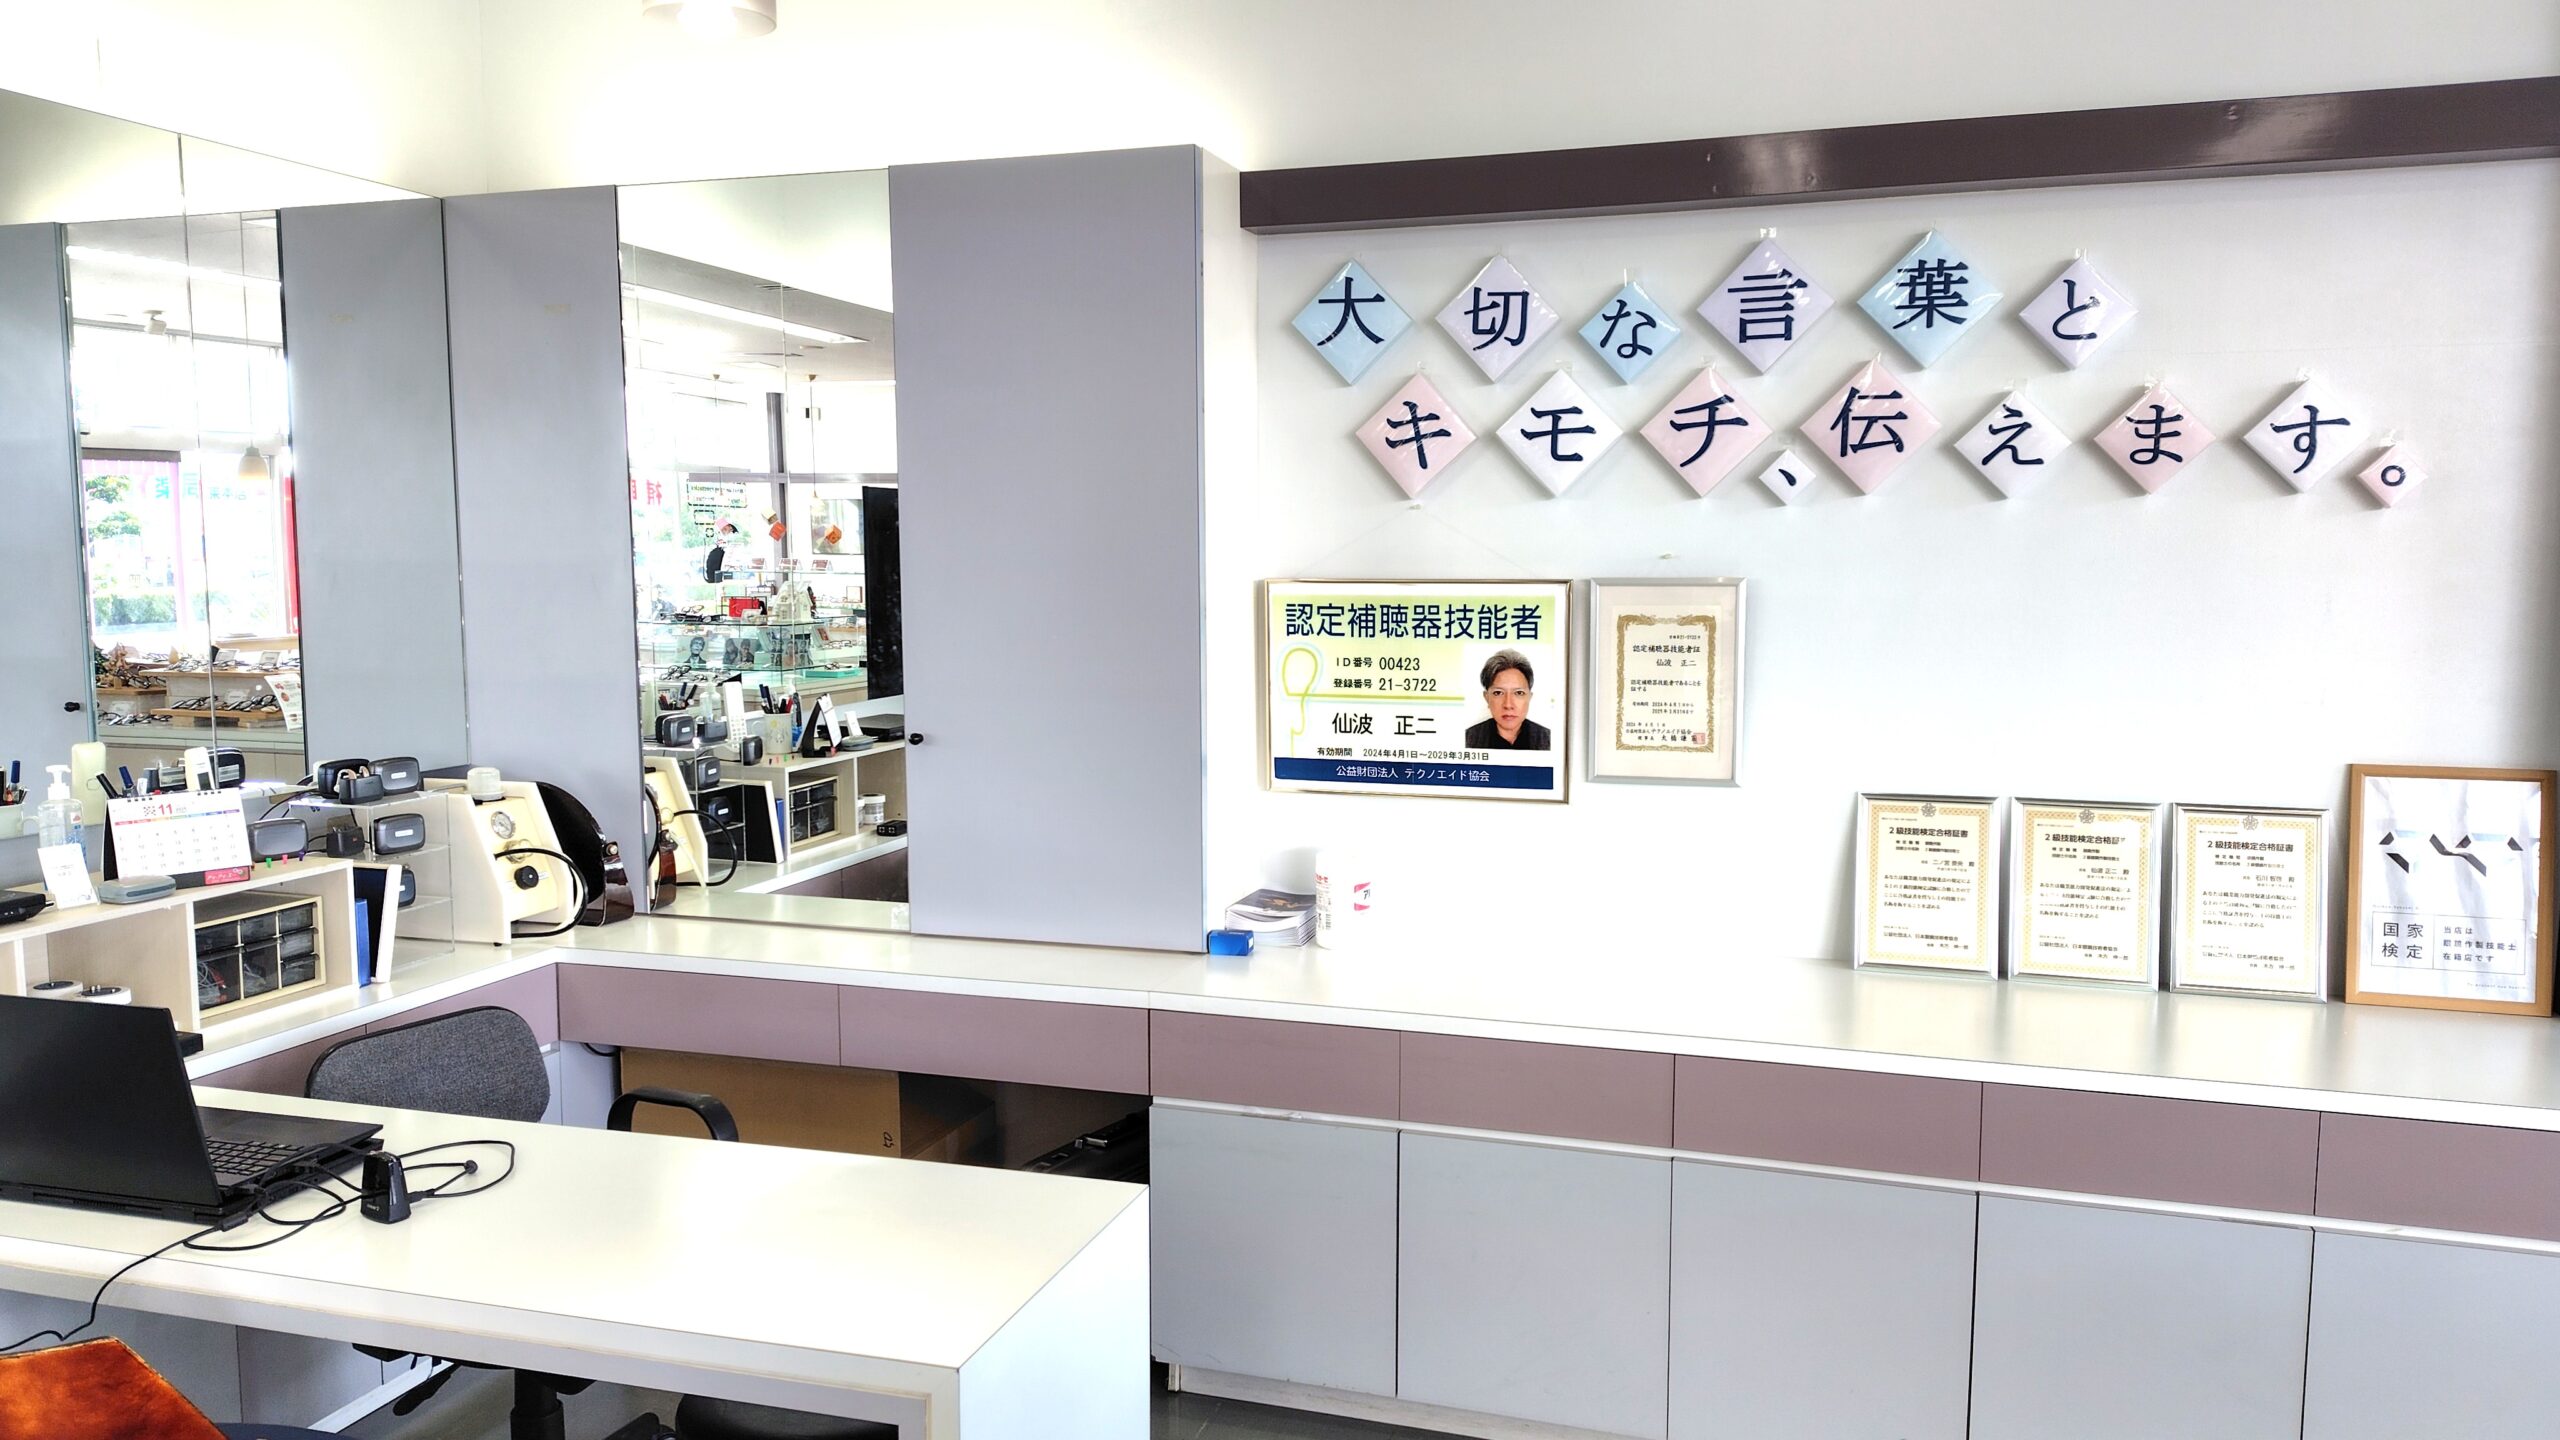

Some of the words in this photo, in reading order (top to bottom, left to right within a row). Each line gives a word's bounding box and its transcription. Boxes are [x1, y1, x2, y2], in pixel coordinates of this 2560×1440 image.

[1317, 257, 2100, 359] 大切な言葉と
[1384, 386, 2407, 488] キモチ、伝えます。
[1285, 603, 1542, 640] 認定補聴器技能者
[1633, 645, 1700, 653] 認定補聴器技能者証
[1379, 657, 1420, 671] 00423
[1333, 677, 1373, 689] 登録番号
[1379, 678, 1436, 692] 21-3722
[1332, 713, 1373, 735] 仙波
[1394, 715, 1437, 736] 正二
[1317, 747, 1352, 757] 有効期間
[1335, 765, 1399, 779] 公益財団法人
[1404, 768, 1490, 782] テクノエイド協会
[158, 803, 173, 815] 11
[2208, 841, 2293, 852] 2級技能検定合格証書
[2383, 923, 2423, 938] 国家
[2444, 926, 2473, 934] 当店は
[2382, 943, 2422, 959] 検定
